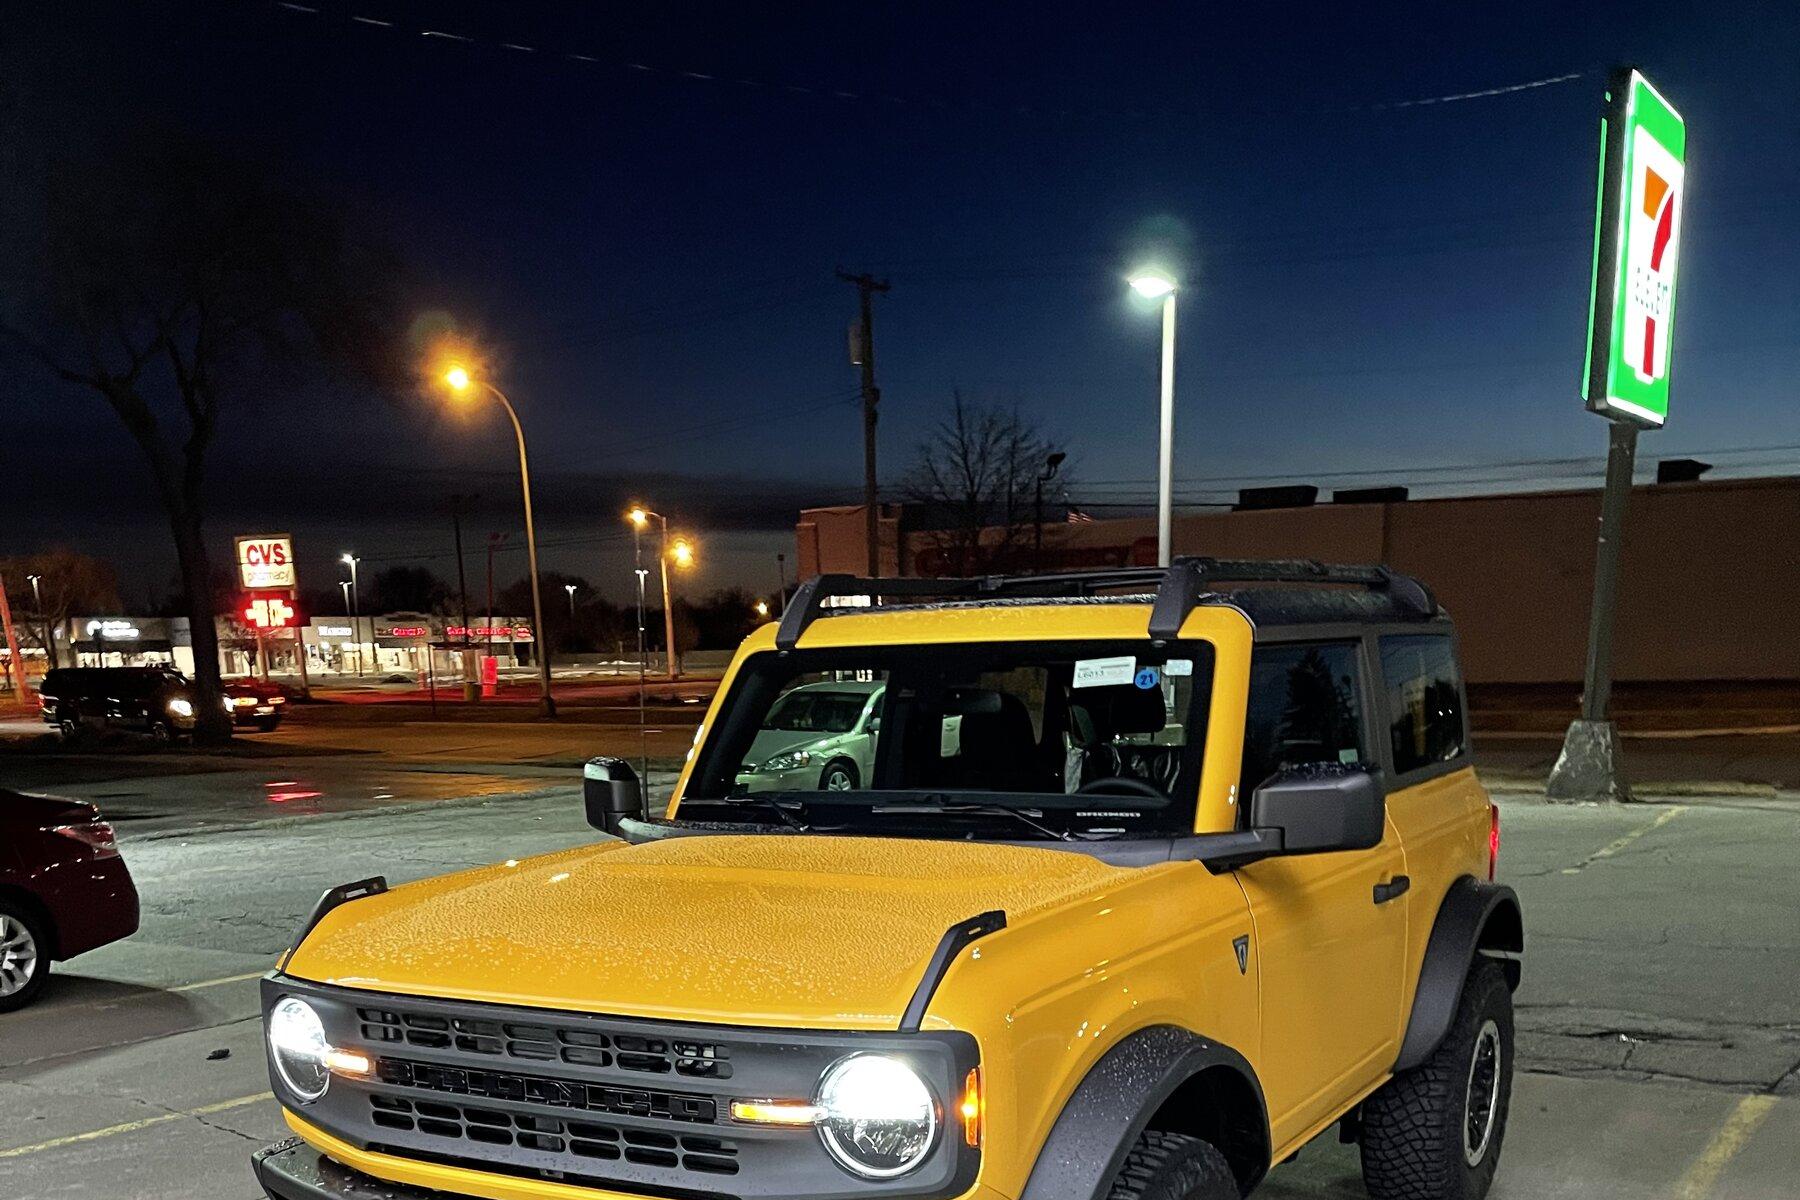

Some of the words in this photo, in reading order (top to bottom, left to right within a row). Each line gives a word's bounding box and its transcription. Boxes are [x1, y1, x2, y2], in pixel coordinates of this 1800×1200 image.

[246, 543, 286, 567] CVS
[1140, 673, 1154, 686] 21
[376, 1055, 717, 1122] BRONCO
